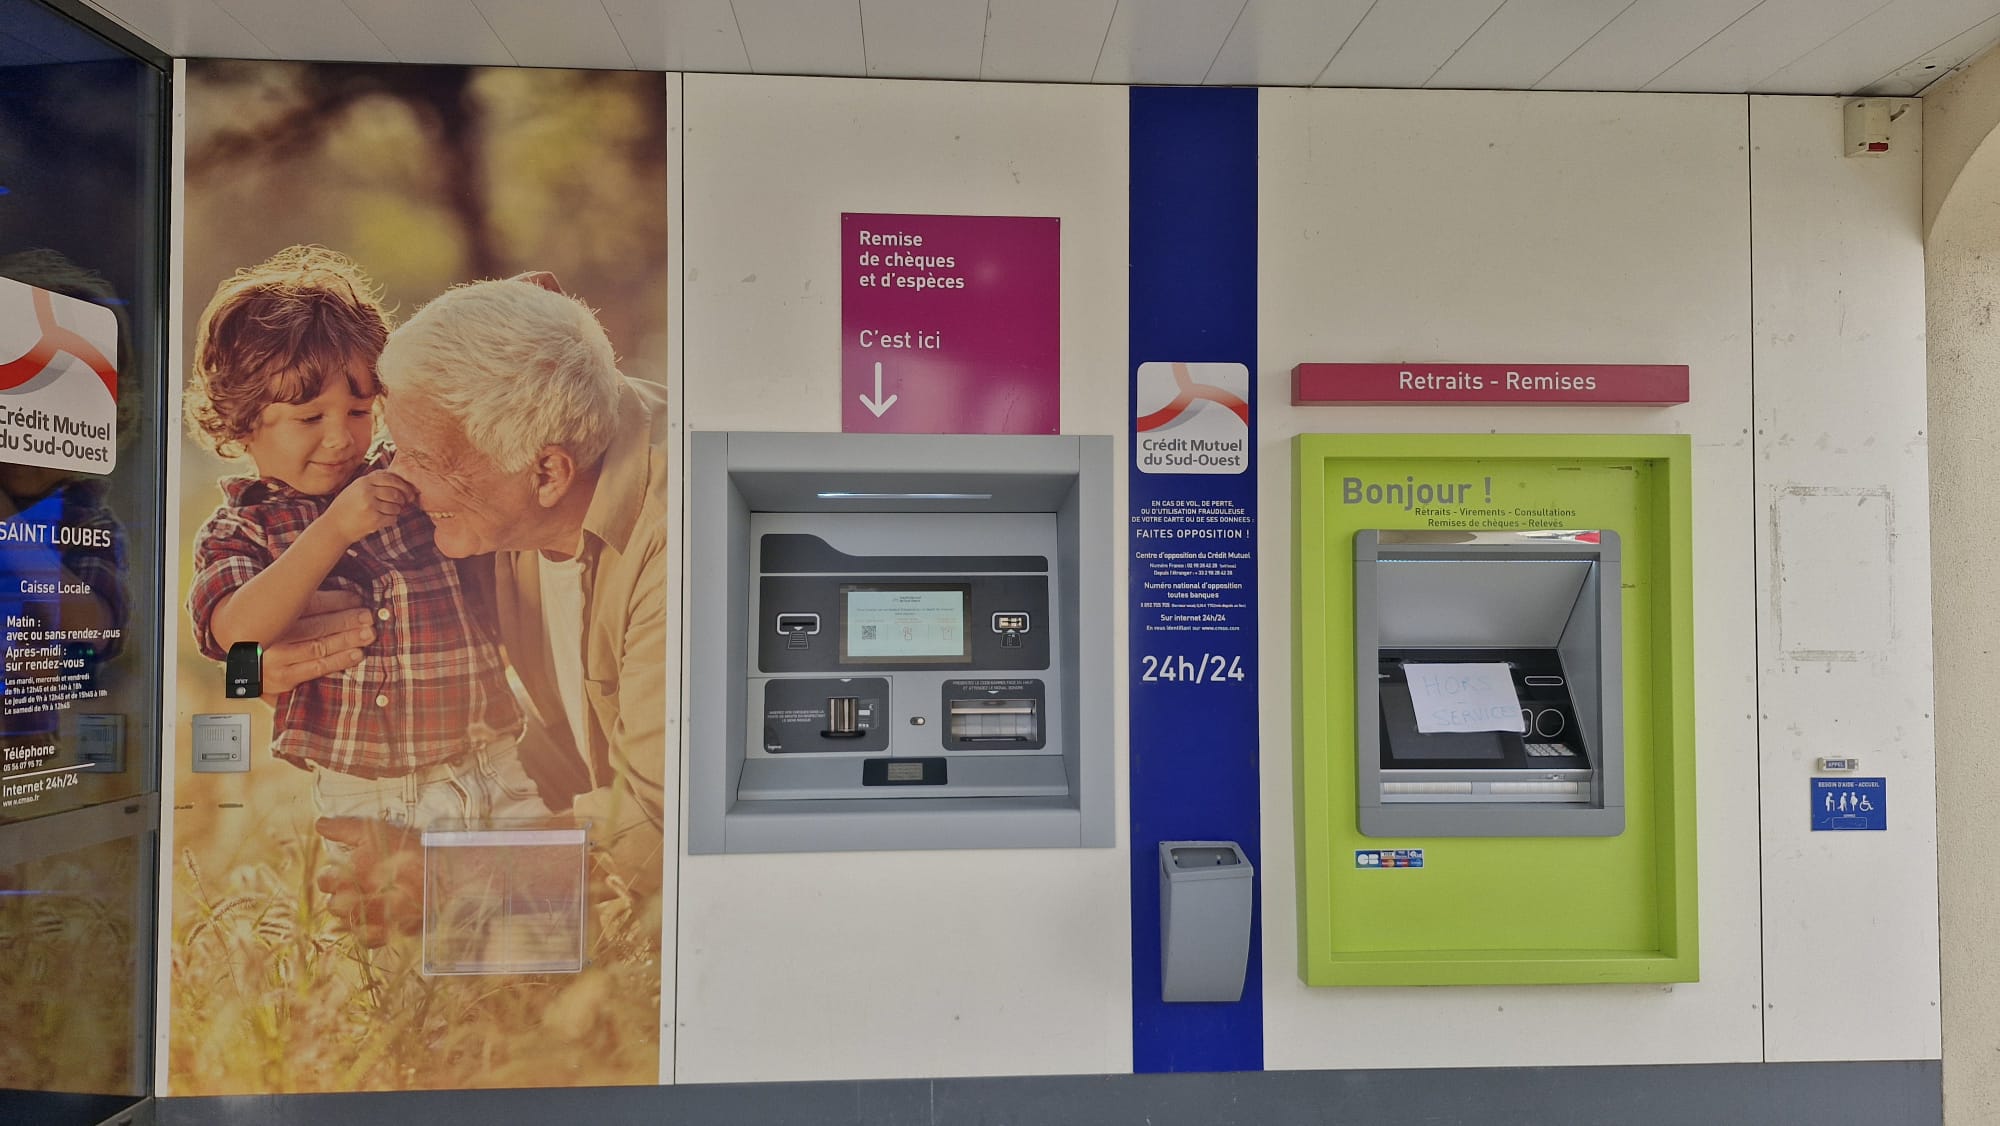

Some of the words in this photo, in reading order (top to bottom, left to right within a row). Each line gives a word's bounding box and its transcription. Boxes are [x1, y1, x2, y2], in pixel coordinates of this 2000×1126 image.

[859, 230, 923, 247] Remise
[859, 251, 880, 266] de
[885, 251, 956, 271] chèques
[859, 273, 876, 287] et
[881, 272, 965, 292] d'espèces
[859, 329, 912, 349] C'est
[918, 330, 941, 349] ici
[1399, 370, 1484, 391] Retraits
[1505, 371, 1597, 392] Remises
[0, 404, 50, 432] Crédit
[53, 415, 111, 441] Mutuel
[0, 428, 19, 450] du
[23, 433, 109, 462] Sud-Ouest
[1142, 438, 1188, 452] Crédit
[1190, 439, 1243, 452] Mutuel
[1143, 453, 1163, 466] du
[1165, 453, 1241, 467] Sud-Ouest
[1343, 476, 1472, 512] Bonjour
[1484, 477, 1493, 504] !
[1211, 500, 1234, 508] PERTE,
[1415, 507, 1451, 517] Retraits
[1459, 507, 1506, 517] Virements
[1514, 507, 1577, 517] Consultations
[1428, 518, 1467, 528] Remises
[1468, 519, 1480, 528] de
[1482, 518, 1519, 529] chèques
[1528, 518, 1563, 528] Relevés
[0, 521, 48, 544] SAINT
[51, 525, 112, 548] LOUBES
[1136, 529, 1174, 539] FAITES
[1176, 529, 1242, 539] OPPOSITION
[1246, 529, 1250, 539] !
[1158, 551, 1197, 561] d'opposition
[1207, 551, 1227, 559] Crédit
[20, 579, 56, 594] Caisse
[57, 580, 91, 595] Locale
[1201, 582, 1243, 591] d'opposition
[1189, 592, 1220, 600] banques
[7, 616, 35, 628] Matin
[1202, 614, 1226, 622] 24h/24
[6, 630, 29, 641] avec
[31, 631, 42, 640] ou
[44, 630, 66, 640] sans
[6, 643, 61, 660] Après-midi
[6, 661, 23, 672] sur
[25, 657, 85, 671] rendez-vous
[1142, 653, 1245, 684] 24h/24
[5, 678, 16, 686] Les
[17, 676, 35, 685] mardi,
[36, 675, 60, 684] mercredi
[1422, 671, 1492, 697] HORS
[5, 688, 13, 696] de
[13, 687, 21, 695] 9h
[26, 685, 43, 694] 12h45
[13, 696, 27, 706] jeudi
[12, 705, 34, 714] samedi
[34, 704, 41, 712] de
[4, 745, 55, 760] Téléphone
[3, 763, 11, 772] 05
[19, 761, 26, 770] 07
[3, 781, 43, 797] Internet
[45, 774, 78, 789] 24h/24
